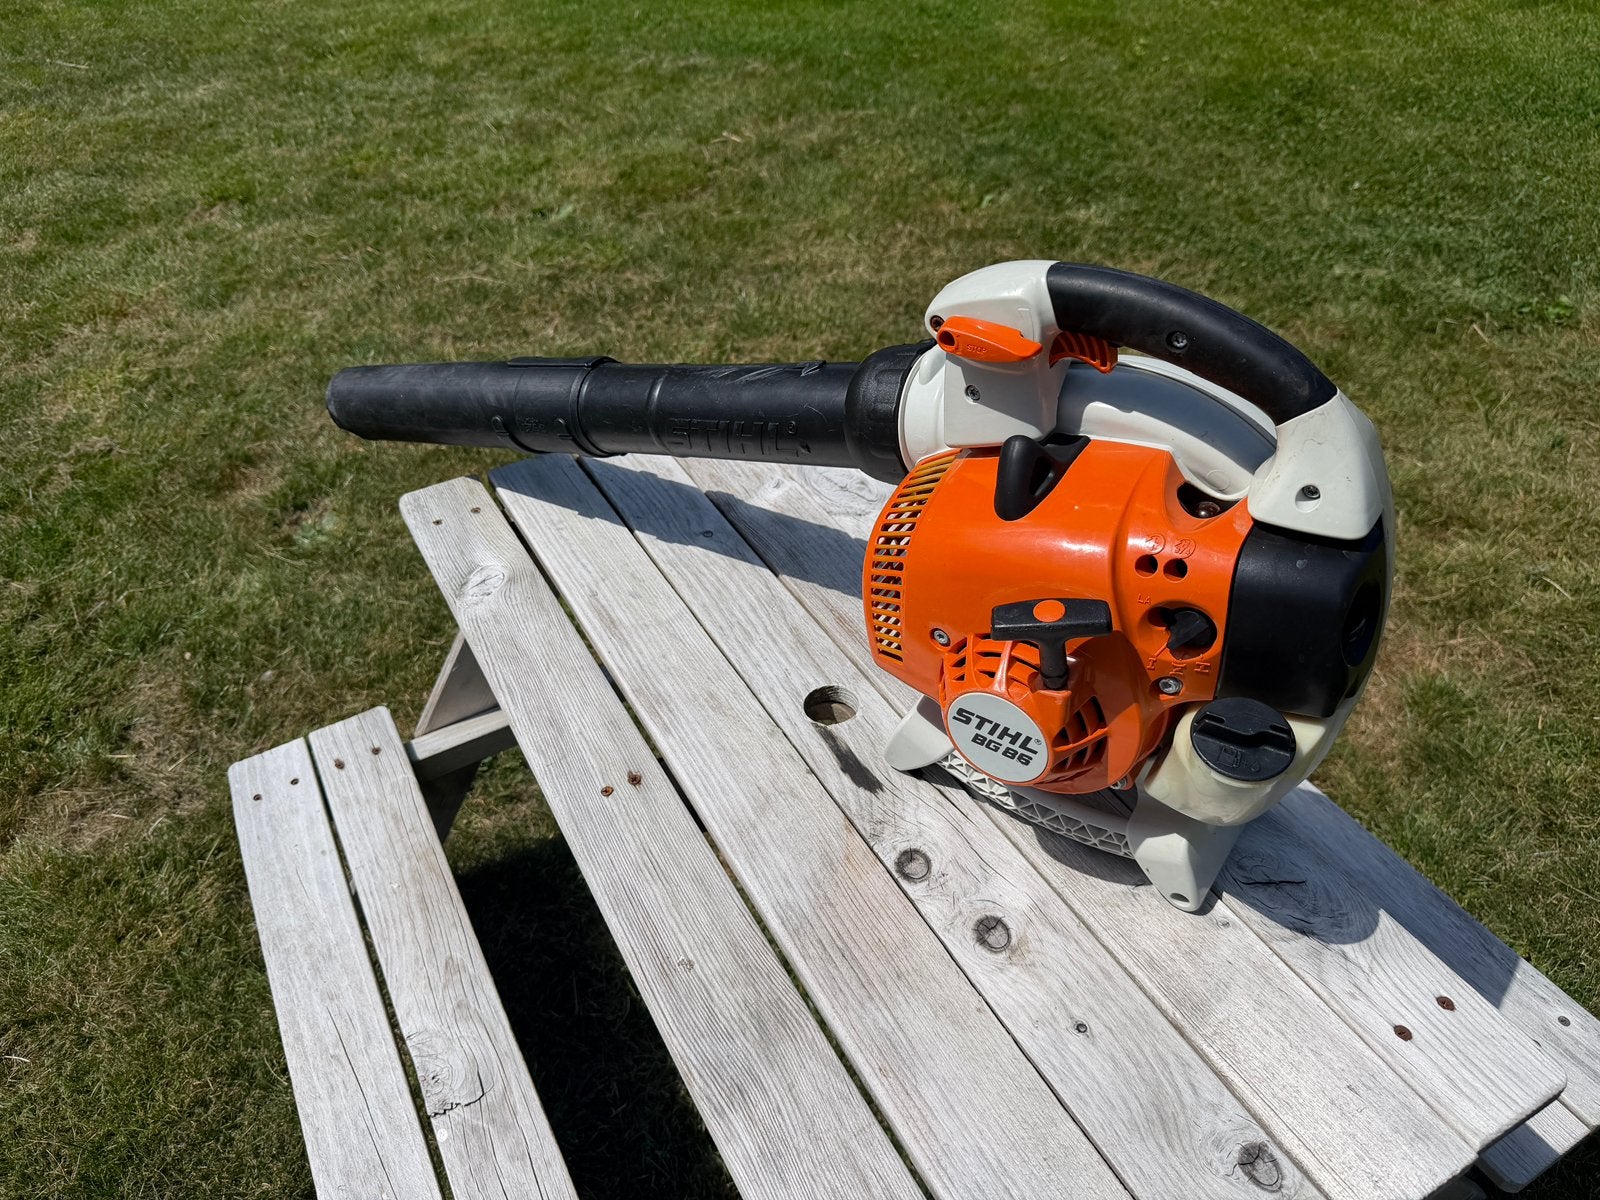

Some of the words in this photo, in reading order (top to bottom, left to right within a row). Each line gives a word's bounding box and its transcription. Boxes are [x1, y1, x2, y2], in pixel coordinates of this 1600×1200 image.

[667, 417, 799, 458] STIHL
[971, 733, 1003, 753] BG
[1002, 746, 1034, 767] 86
